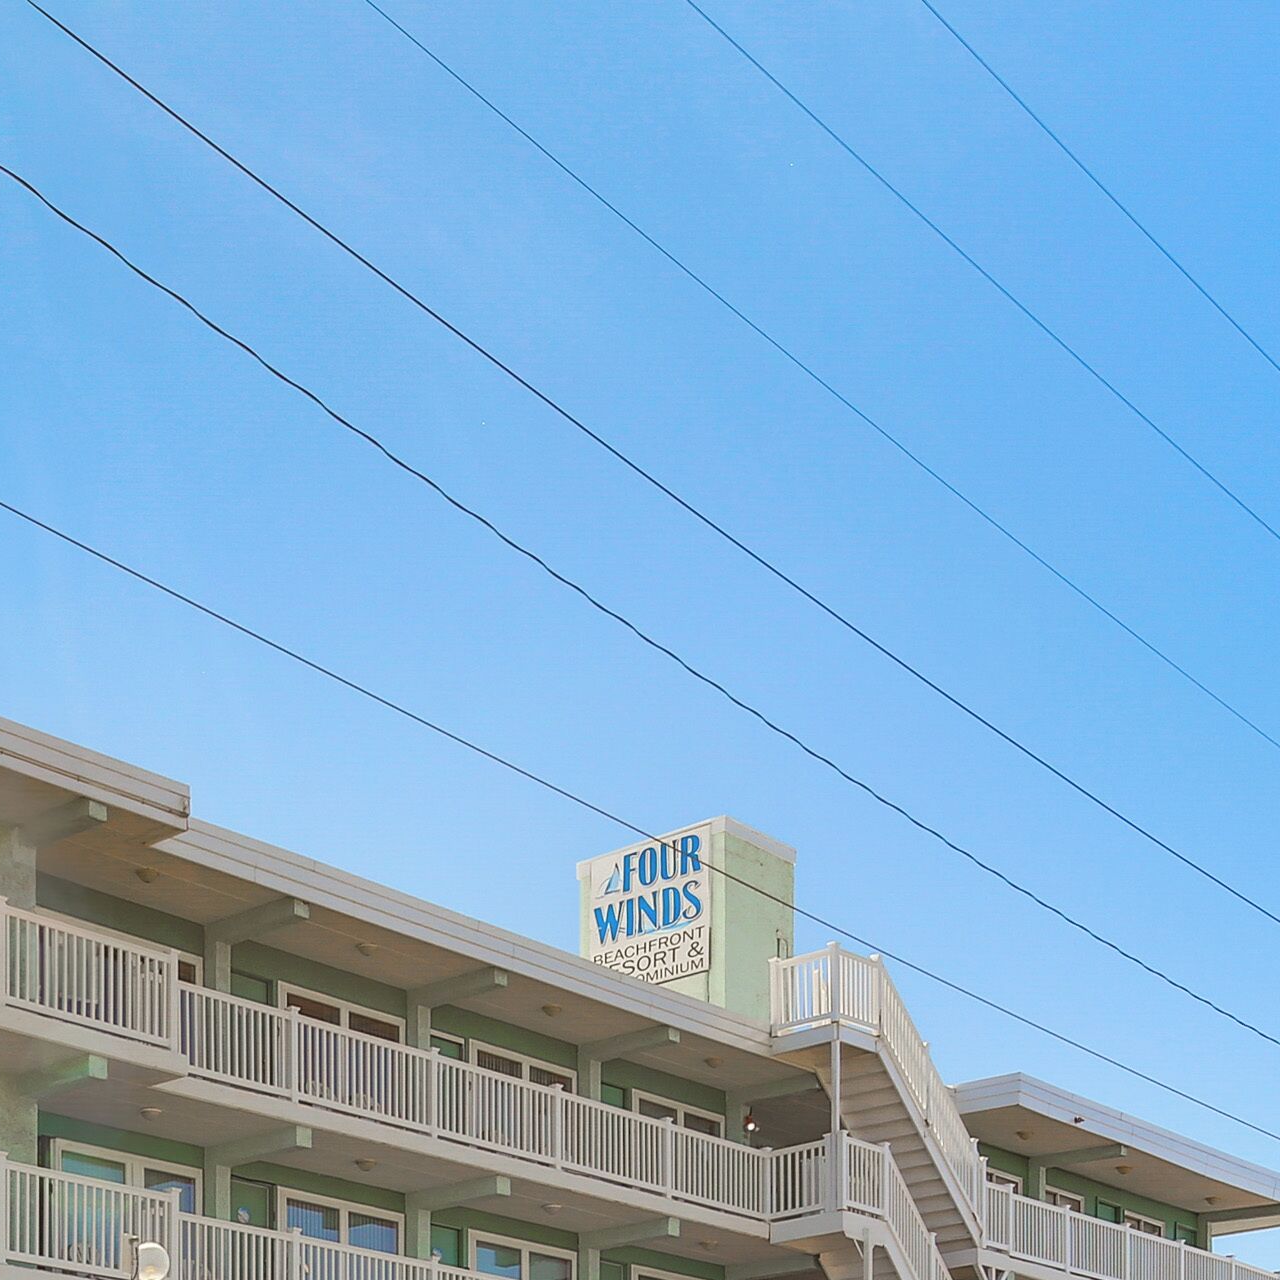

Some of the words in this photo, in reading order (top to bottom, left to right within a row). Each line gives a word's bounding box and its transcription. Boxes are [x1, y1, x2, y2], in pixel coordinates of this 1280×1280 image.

[622, 834, 702, 893] FOUR
[594, 880, 702, 945] WINDS
[593, 925, 705, 966] BEACHFRONT
[687, 941, 705, 958] &
